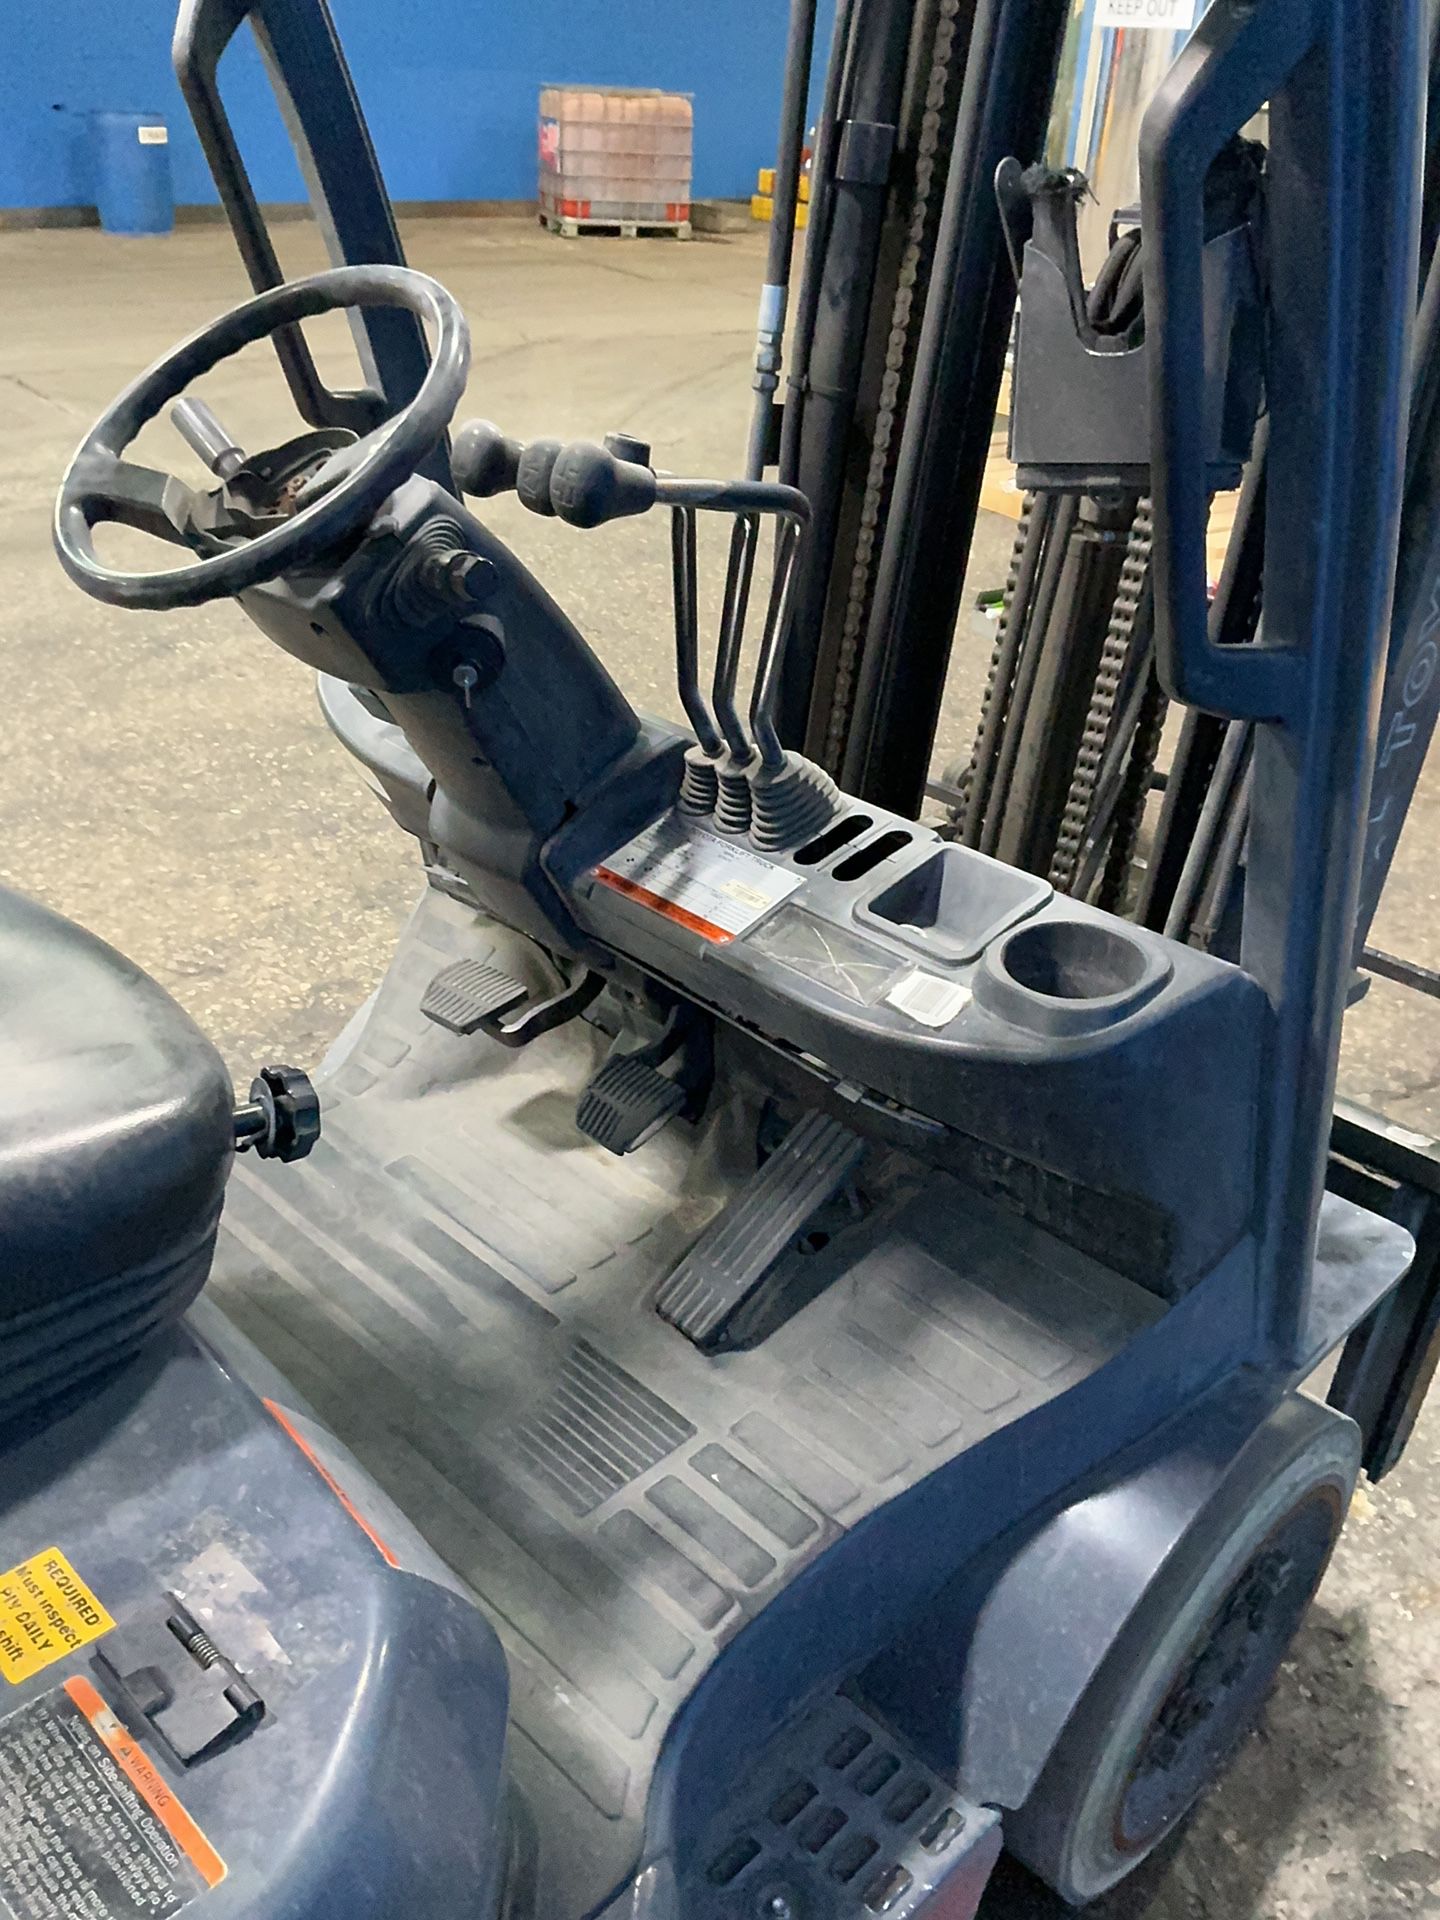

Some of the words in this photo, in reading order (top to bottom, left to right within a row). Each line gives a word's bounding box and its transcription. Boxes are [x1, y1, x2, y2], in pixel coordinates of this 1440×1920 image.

[1107, 0, 1142, 15] KEEP
[1146, 0, 1178, 16] OUT
[43, 1560, 100, 1626] REQUIRED
[15, 1612, 54, 1651] DAILY
[39, 1599, 82, 1649] inspect
[87, 1743, 101, 1758] on
[139, 1816, 180, 1868] Operation
[130, 1756, 169, 1806] WARNING
[42, 1823, 55, 1836] of
[61, 1852, 84, 1879] forks
[86, 1779, 100, 1794] on
[109, 1812, 132, 1840] forks
[129, 1841, 140, 1852] is
[137, 1852, 167, 1889] shifted
[94, 1812, 117, 1840] forks
[101, 1849, 146, 1906] positioned
